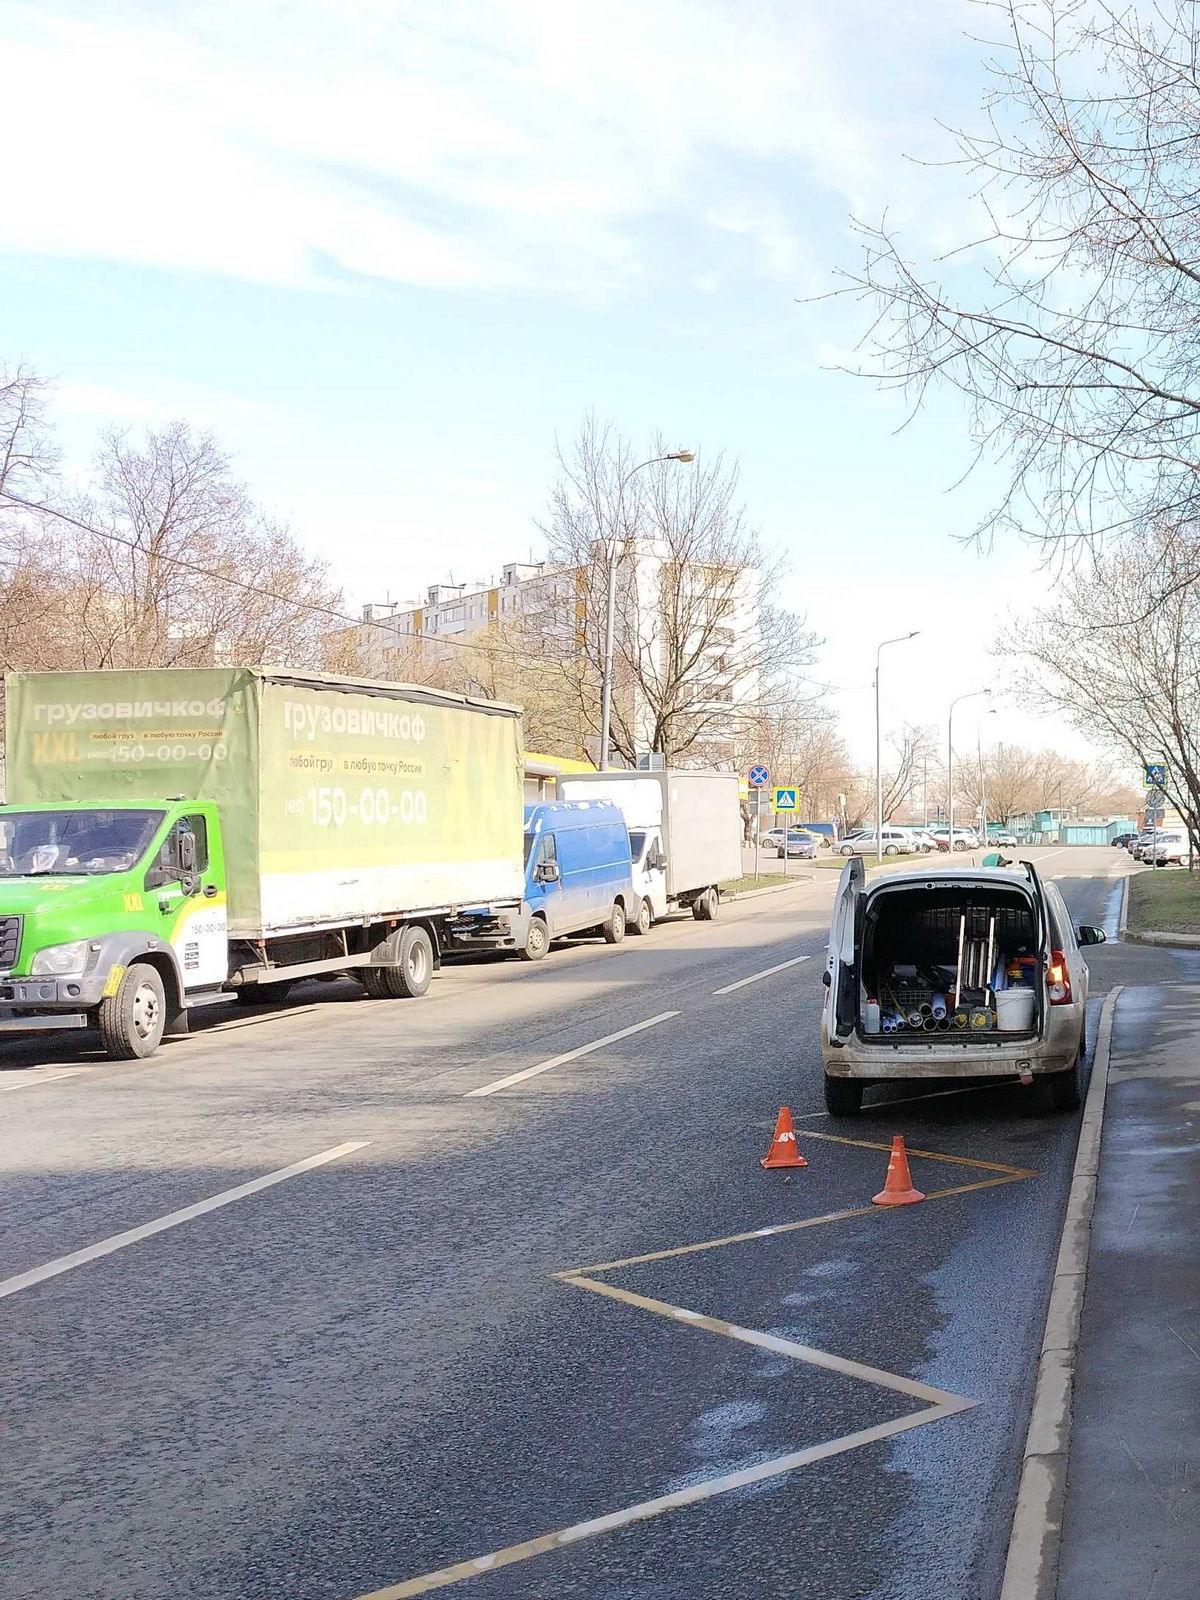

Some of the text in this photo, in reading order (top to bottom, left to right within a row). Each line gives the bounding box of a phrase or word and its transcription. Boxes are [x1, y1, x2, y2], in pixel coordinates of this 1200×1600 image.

[33, 697, 226, 725] грузовичкоф
[284, 701, 426, 744] грузовичкоф
[92, 732, 134, 741] любой груз
[150, 732, 175, 740] любую
[176, 731, 196, 739] точку
[198, 730, 223, 738] России
[33, 732, 81, 763] XXL
[350, 758, 376, 773] любую
[378, 761, 397, 775] точку
[399, 760, 422, 774] России
[308, 787, 427, 826] 150-00-00
[123, 893, 145, 912] XXL
